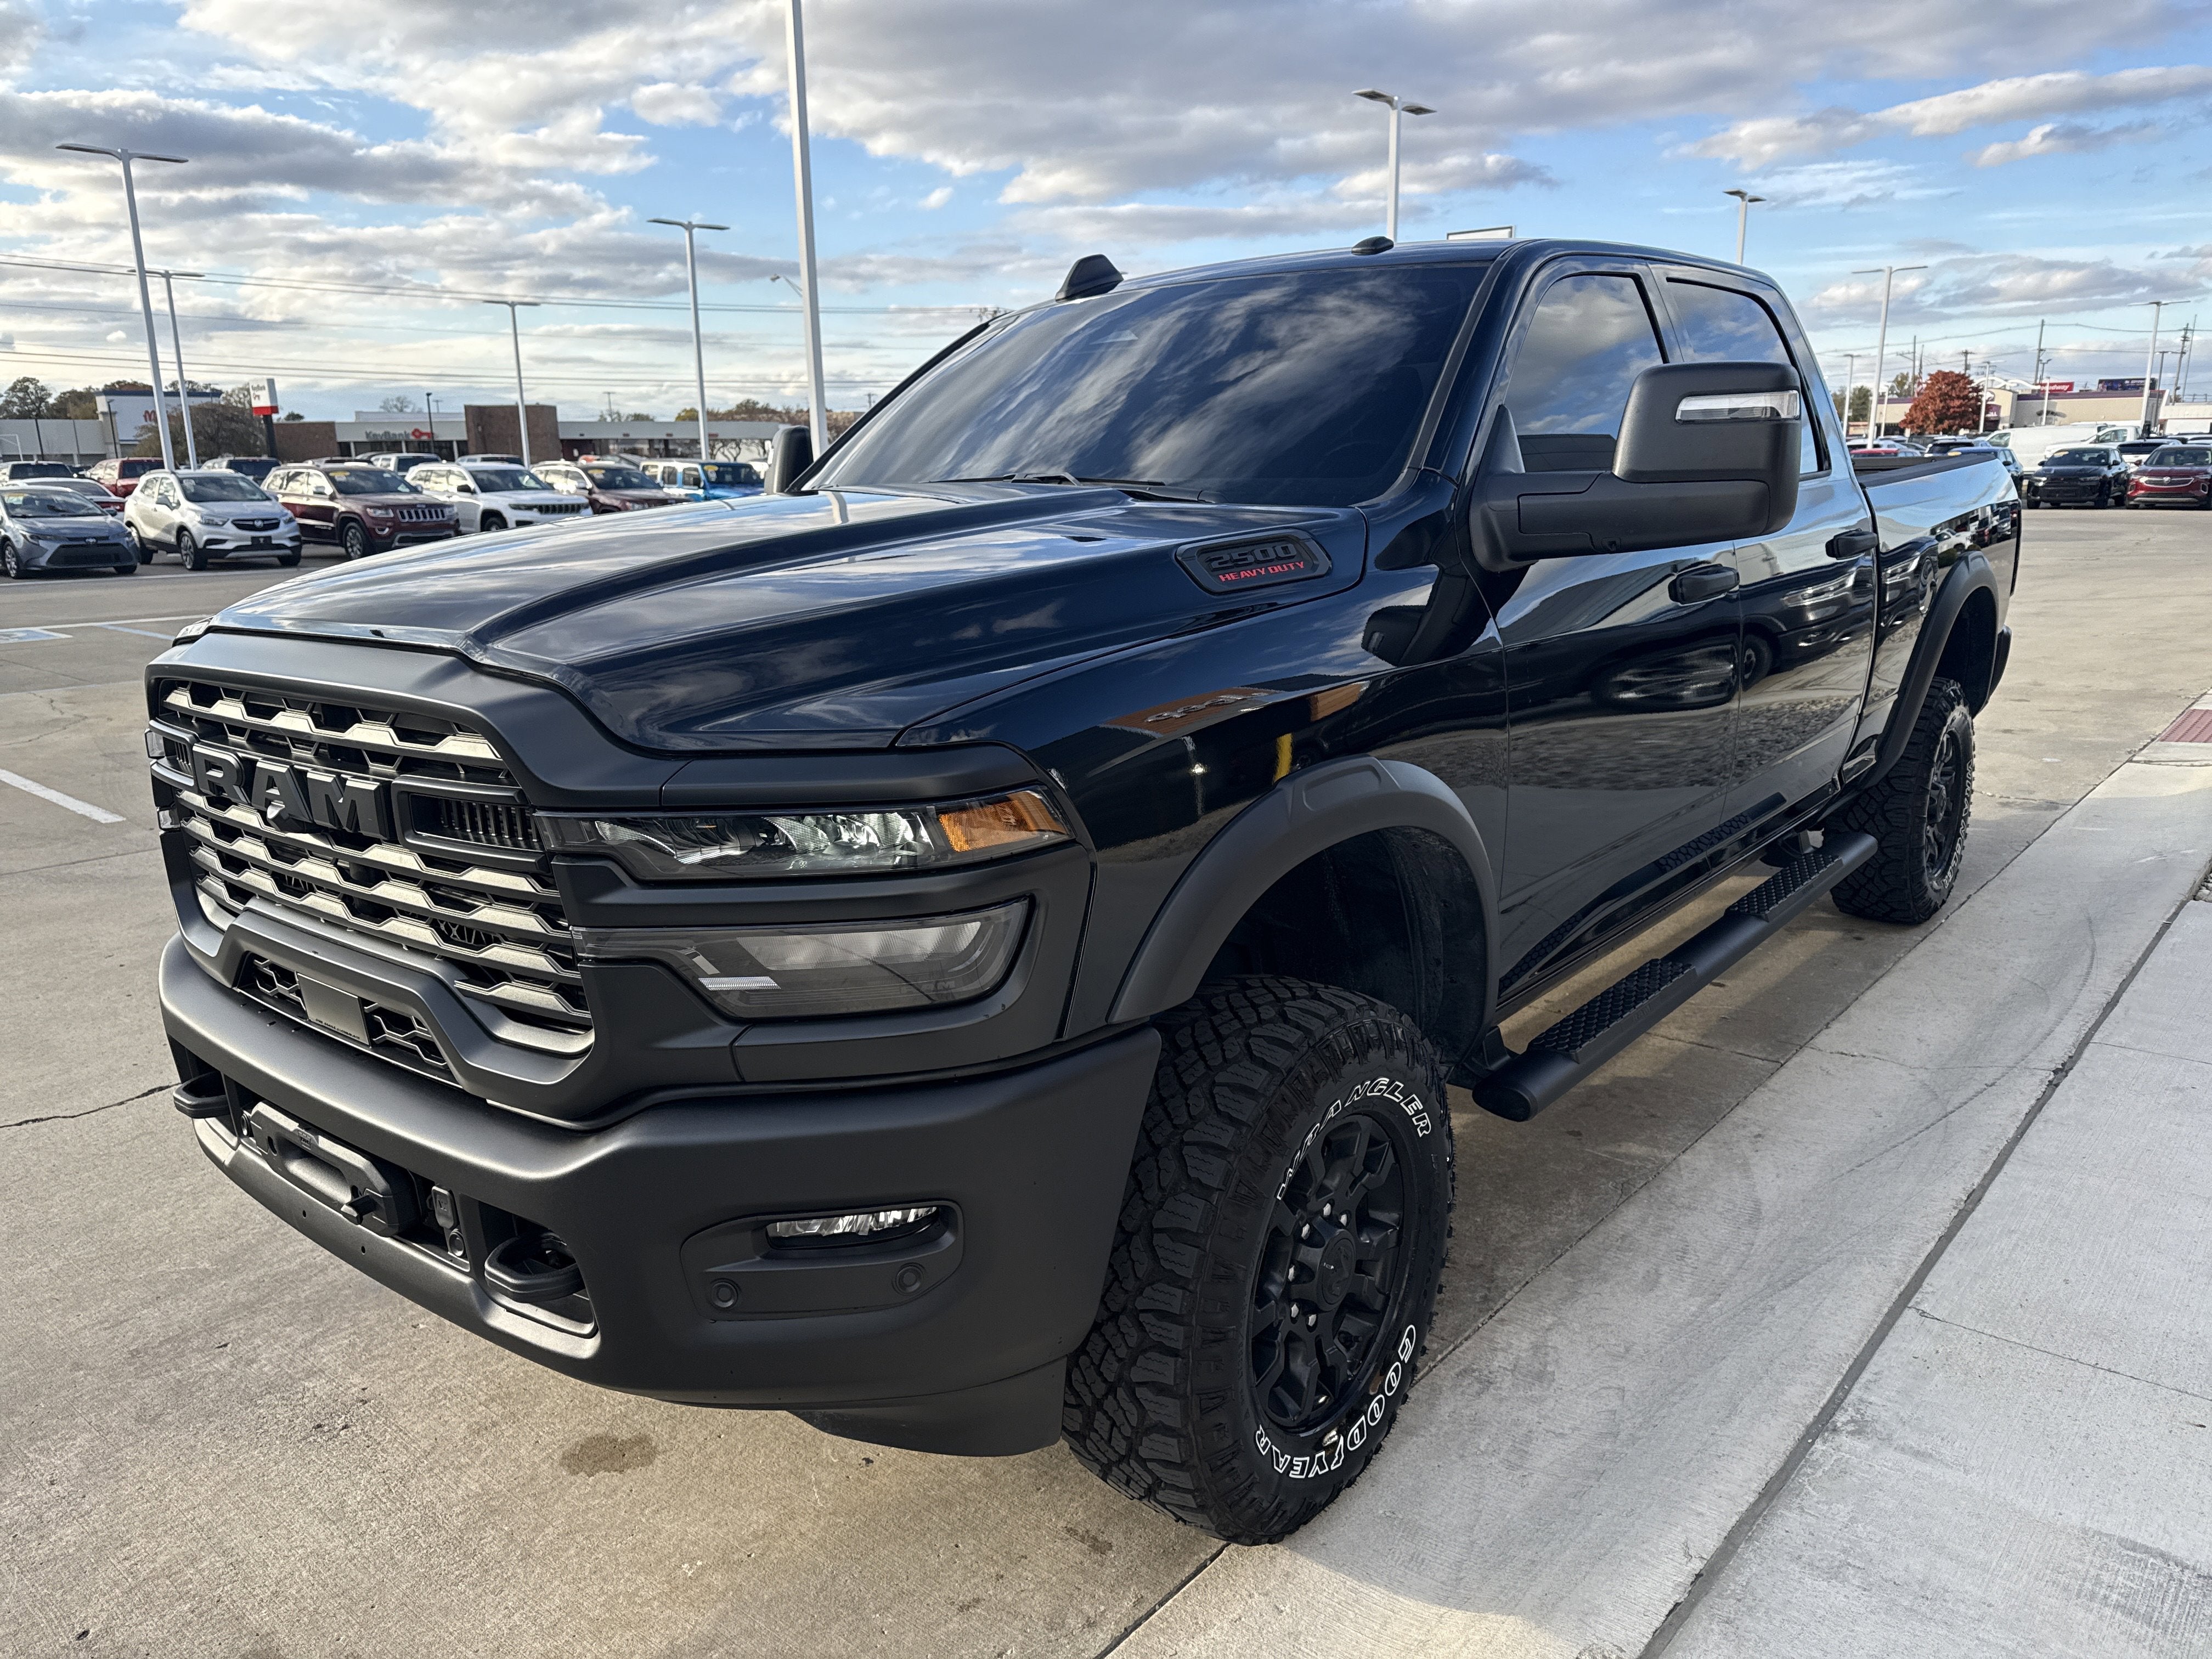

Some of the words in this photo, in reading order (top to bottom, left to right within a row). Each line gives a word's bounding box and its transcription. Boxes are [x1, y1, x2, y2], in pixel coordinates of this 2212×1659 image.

[365, 430, 410, 441] KeyBank
[1206, 544, 1297, 571] 2500
[1219, 567, 1265, 582] HEAVY
[1267, 561, 1305, 574] DUTY
[193, 743, 390, 840] RAM
[1942, 759, 1973, 889] WRANGLER
[1276, 1076, 1431, 1204] WRANGLER
[1255, 1324, 1416, 1479] GOODYEAR
